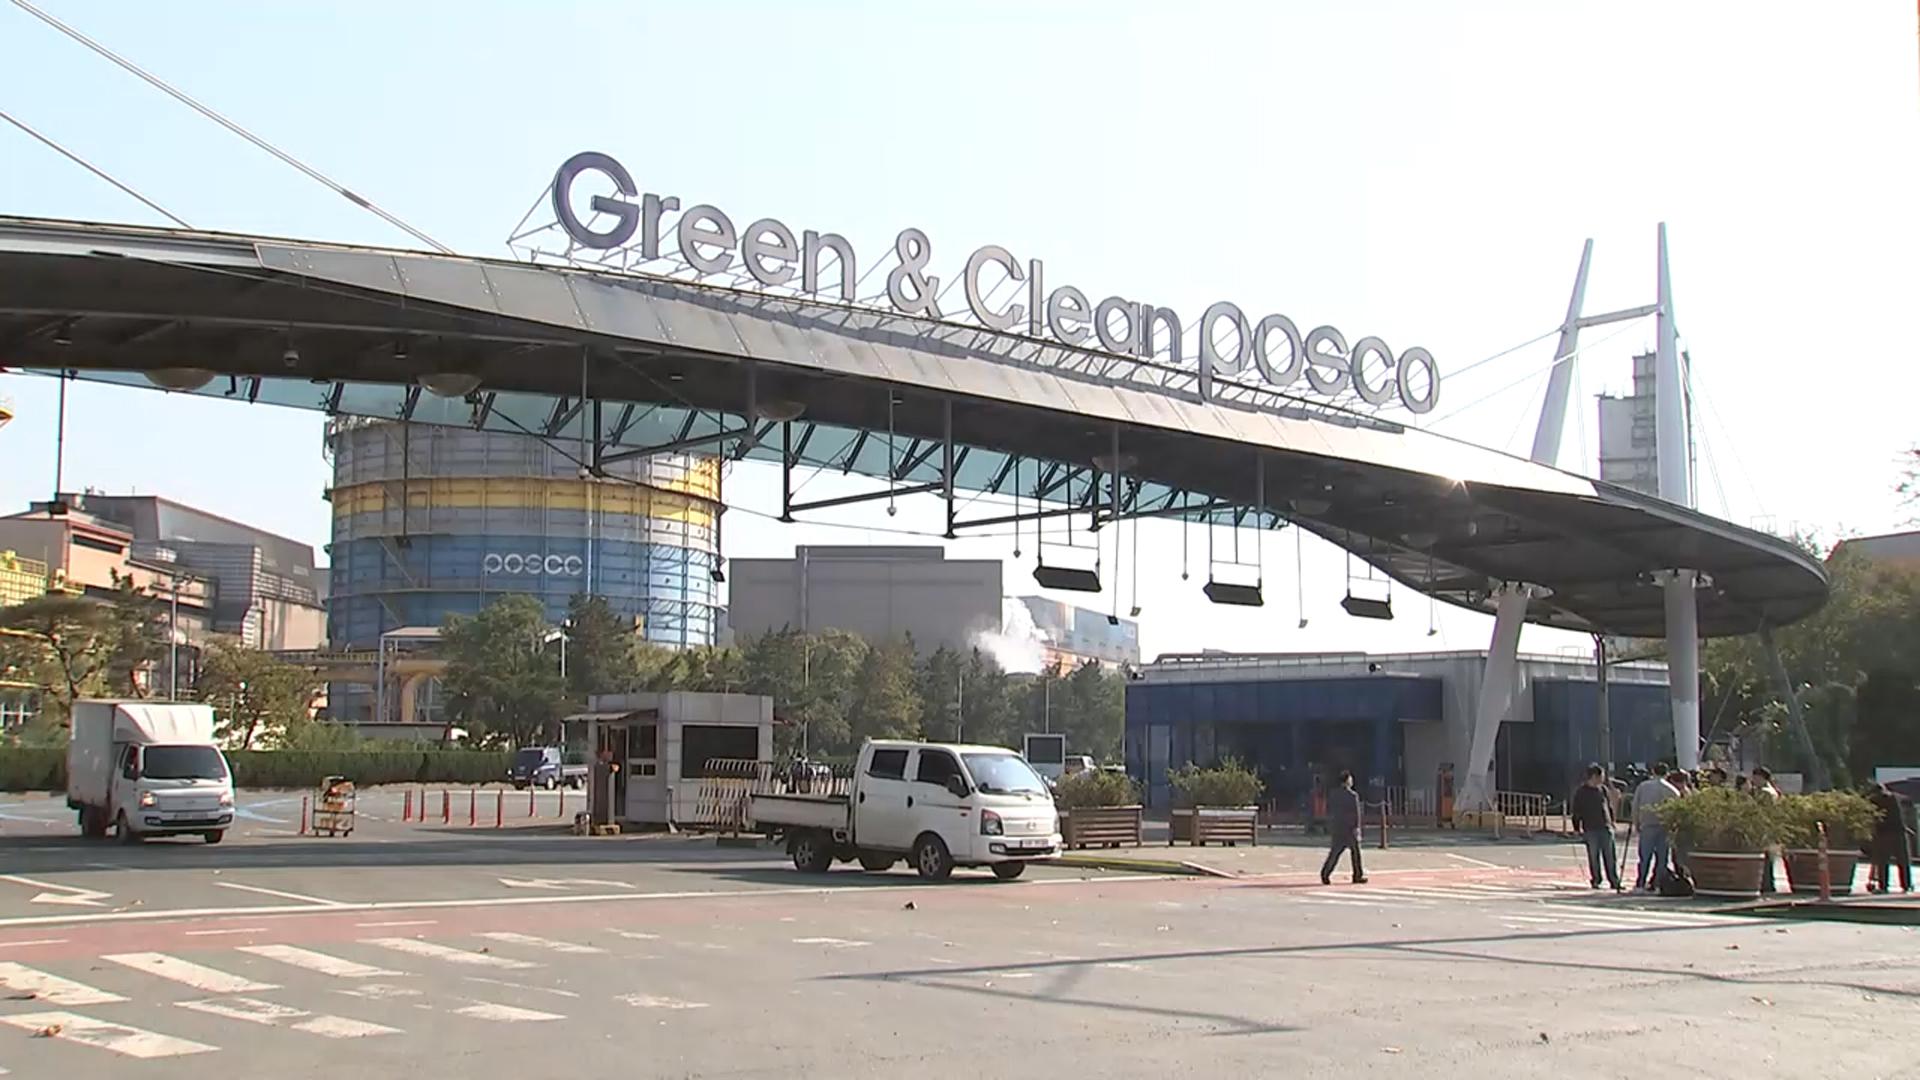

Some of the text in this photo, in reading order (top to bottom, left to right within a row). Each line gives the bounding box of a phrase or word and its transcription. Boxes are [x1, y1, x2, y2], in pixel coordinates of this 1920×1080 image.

[552, 151, 1440, 414] Green & Clean posco
